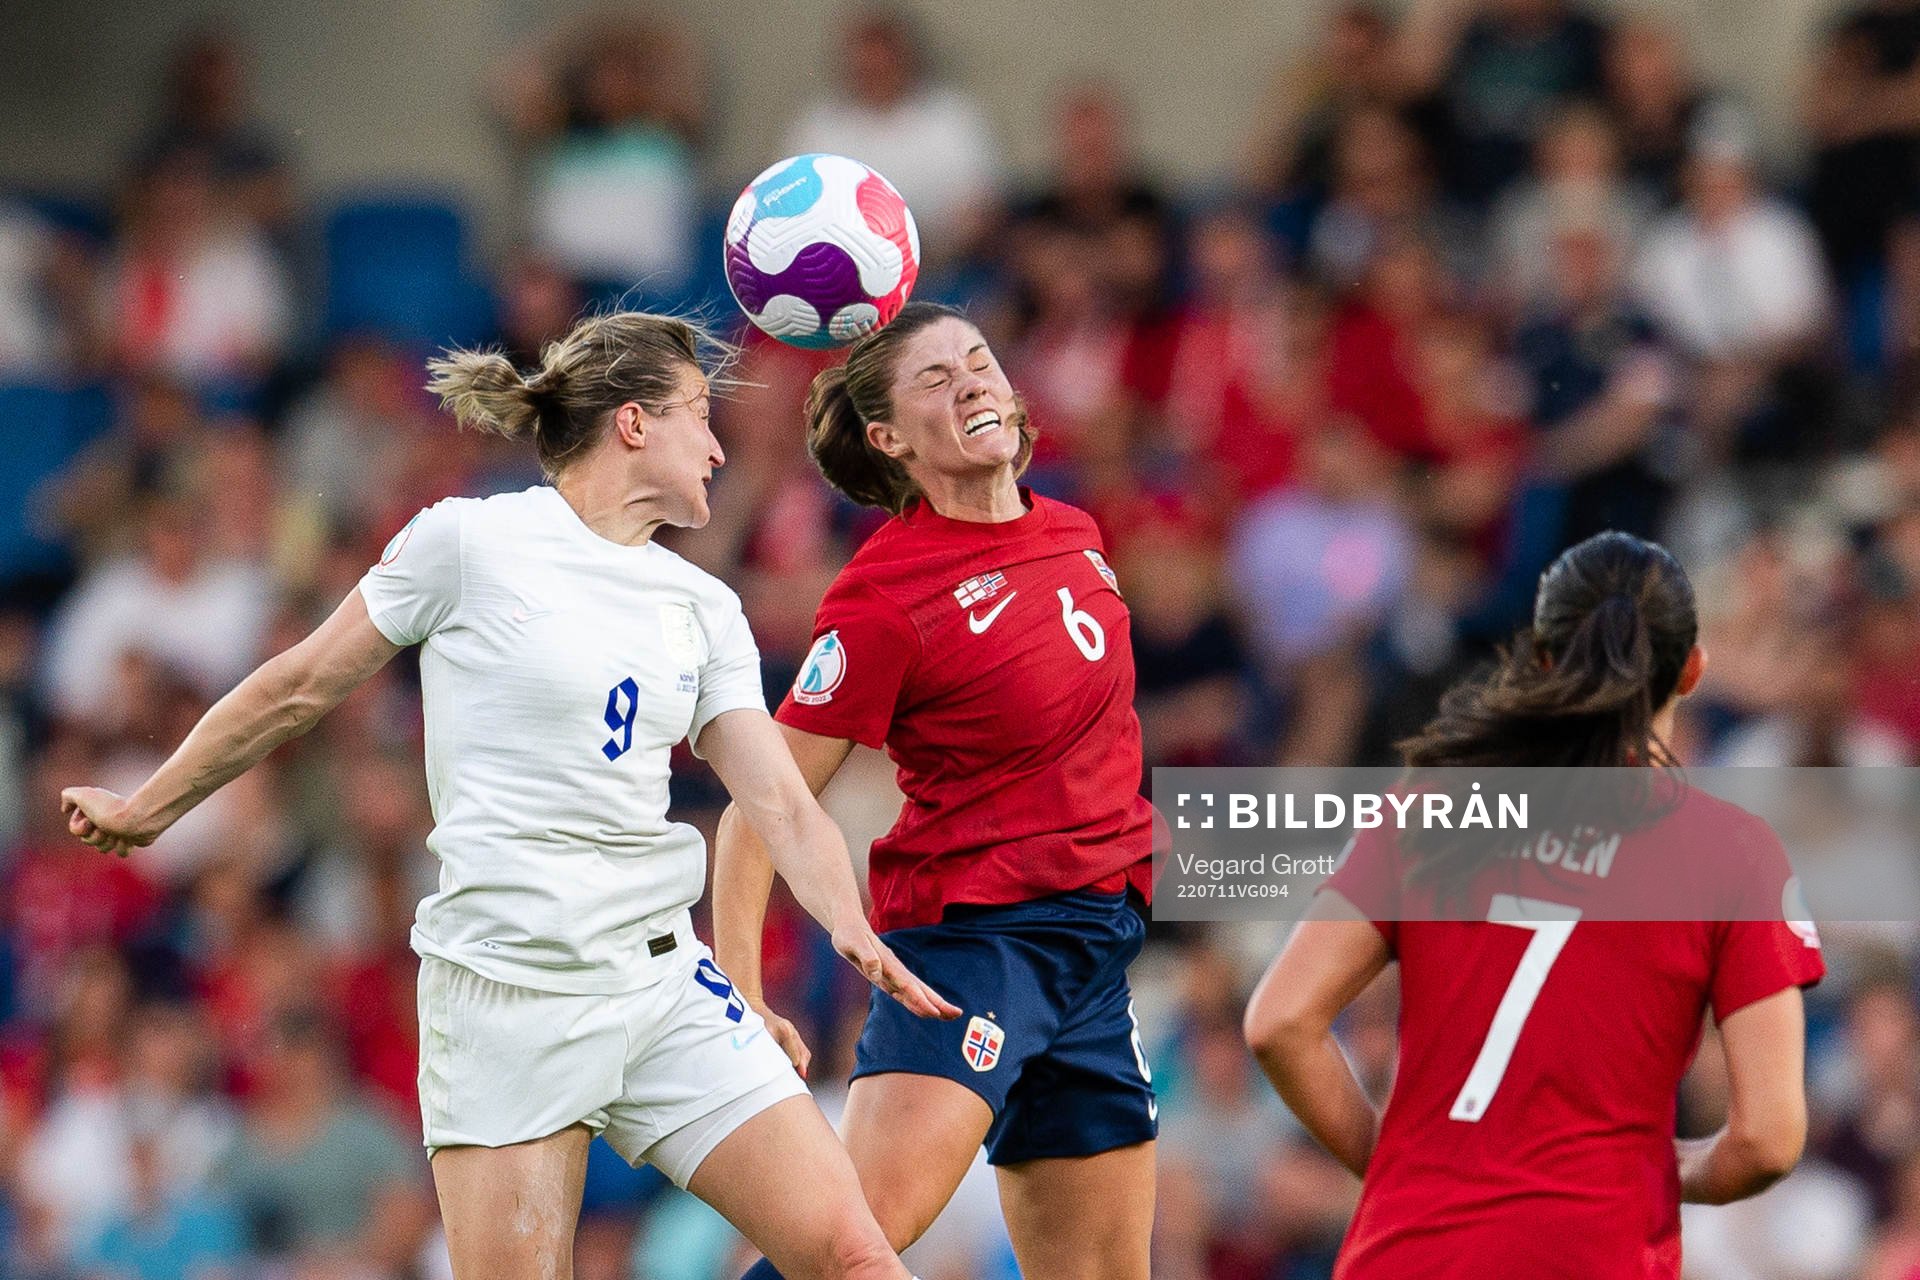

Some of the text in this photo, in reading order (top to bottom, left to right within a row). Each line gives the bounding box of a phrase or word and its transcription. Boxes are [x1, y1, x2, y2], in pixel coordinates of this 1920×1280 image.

[1056, 586, 1105, 662] 6
[601, 676, 639, 762] 9
[694, 958, 745, 1024] 9
[1448, 893, 1583, 1122] 7
